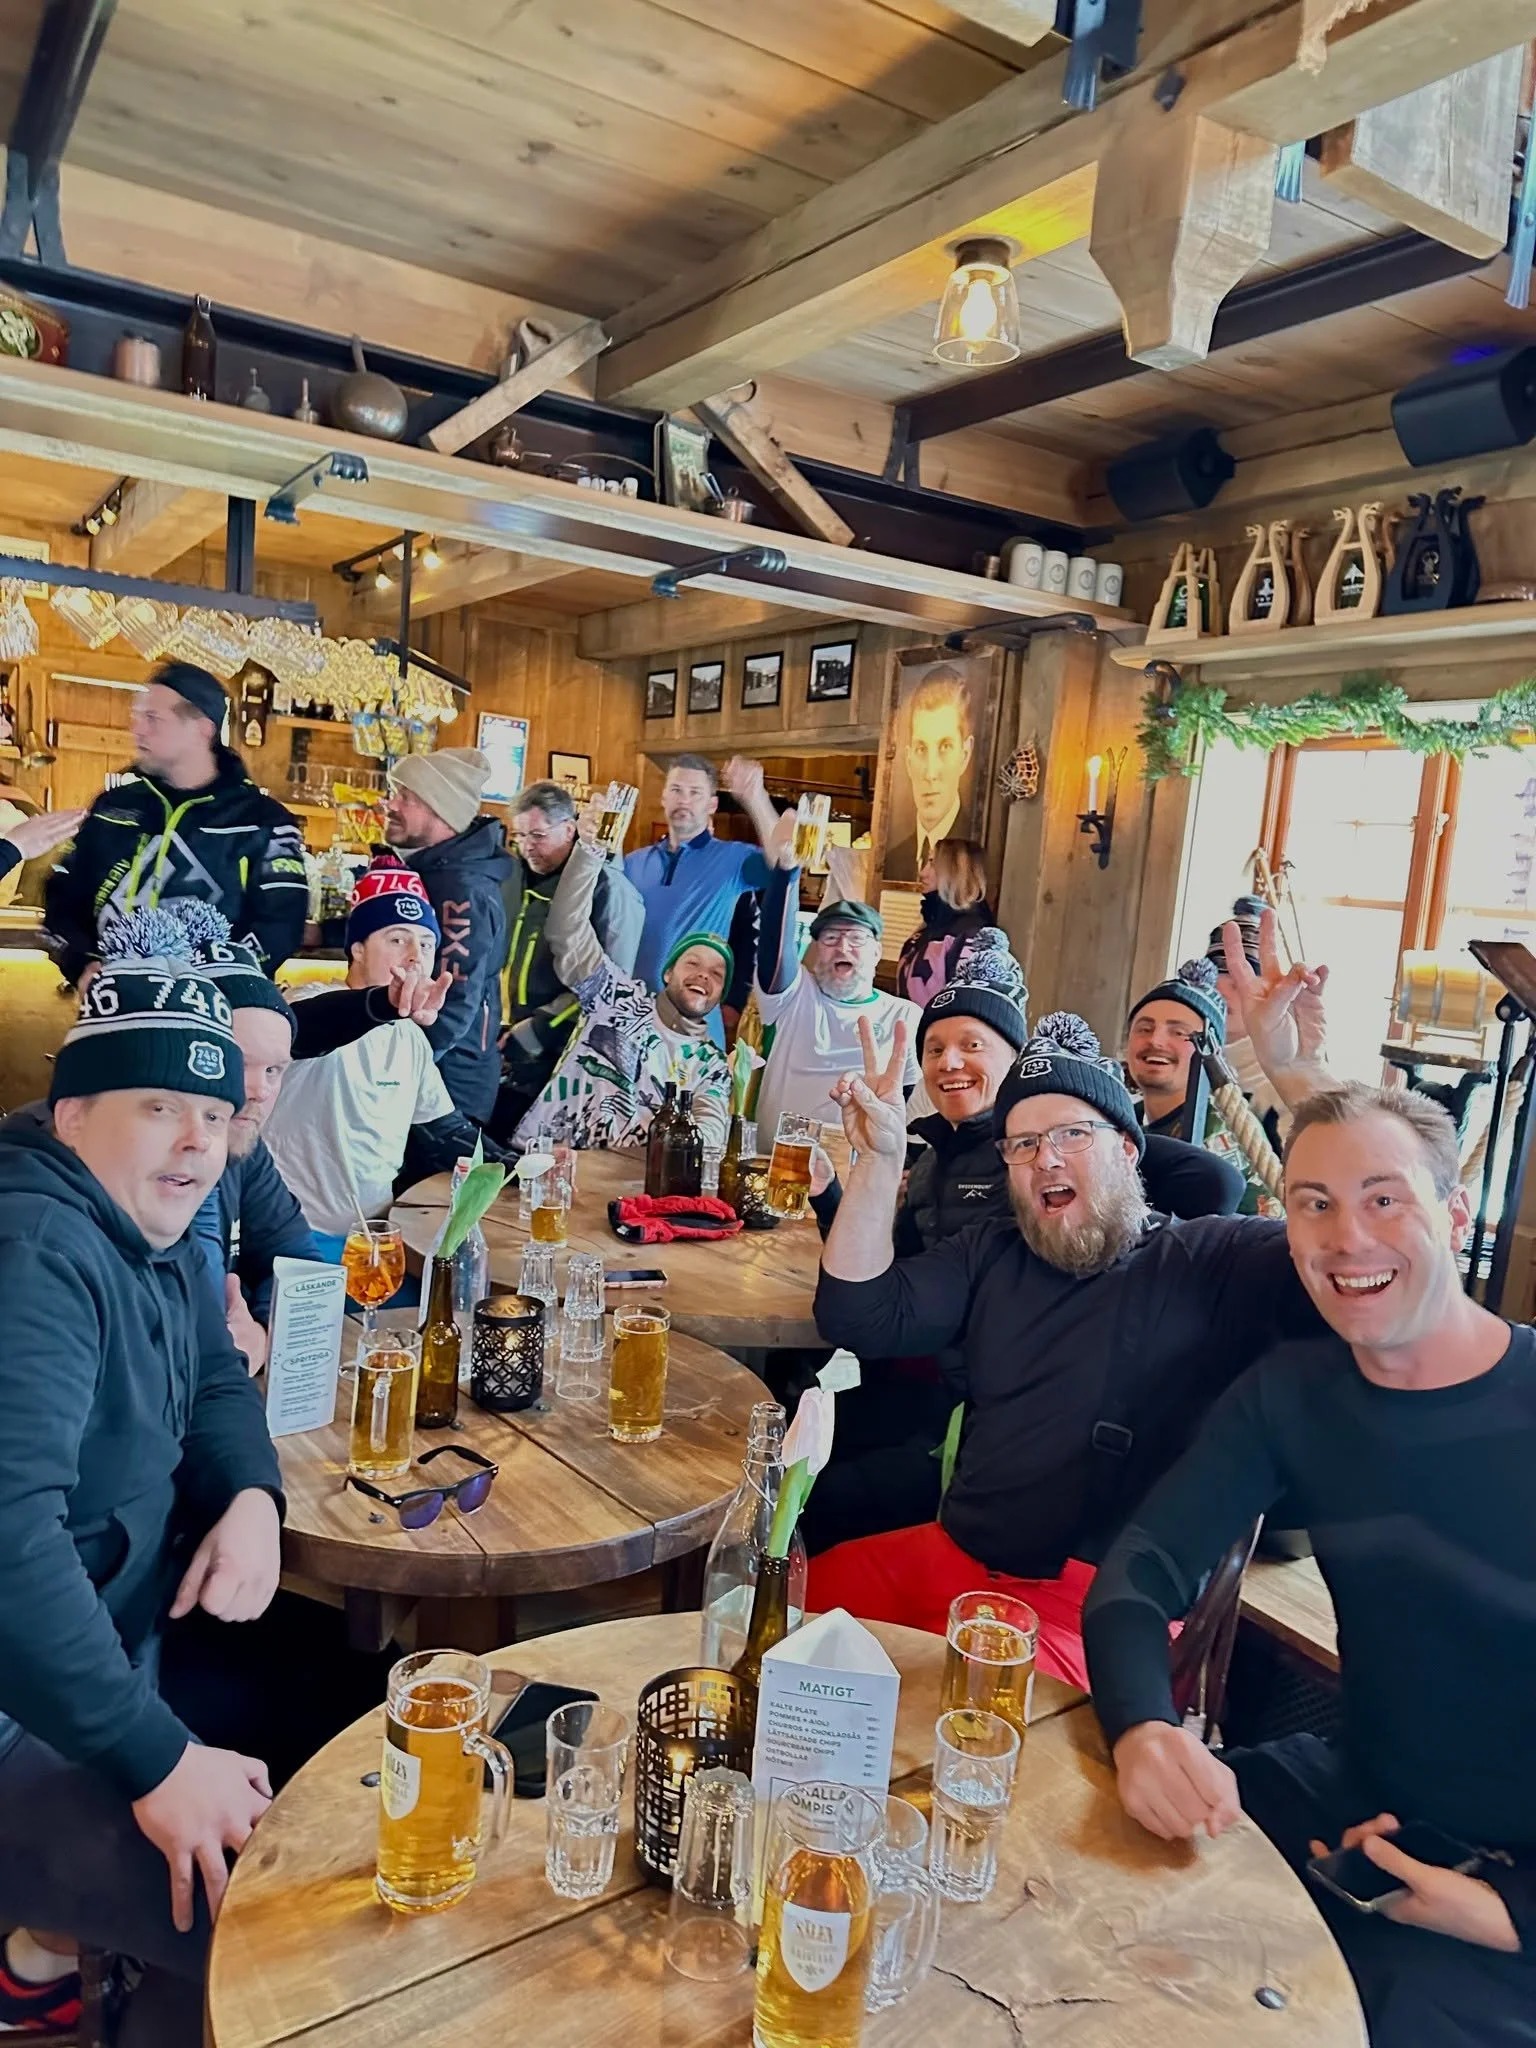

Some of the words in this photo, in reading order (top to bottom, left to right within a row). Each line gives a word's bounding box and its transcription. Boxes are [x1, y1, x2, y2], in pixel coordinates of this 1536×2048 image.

[371, 875, 423, 896] 746
[441, 900, 471, 982] FXR
[148, 975, 233, 1028] 746
[799, 1681, 855, 1698] MATIGT
[769, 1710, 801, 1723] POMMES
[795, 1706, 818, 1716] PLATE
[768, 1719, 803, 1733] CHURROS
[811, 1728, 861, 1740] CHOKLADSÅS
[813, 1747, 835, 1756] CHIPS
[819, 1739, 841, 1748] CHIPS
[785, 1792, 854, 1815] OMPISR
